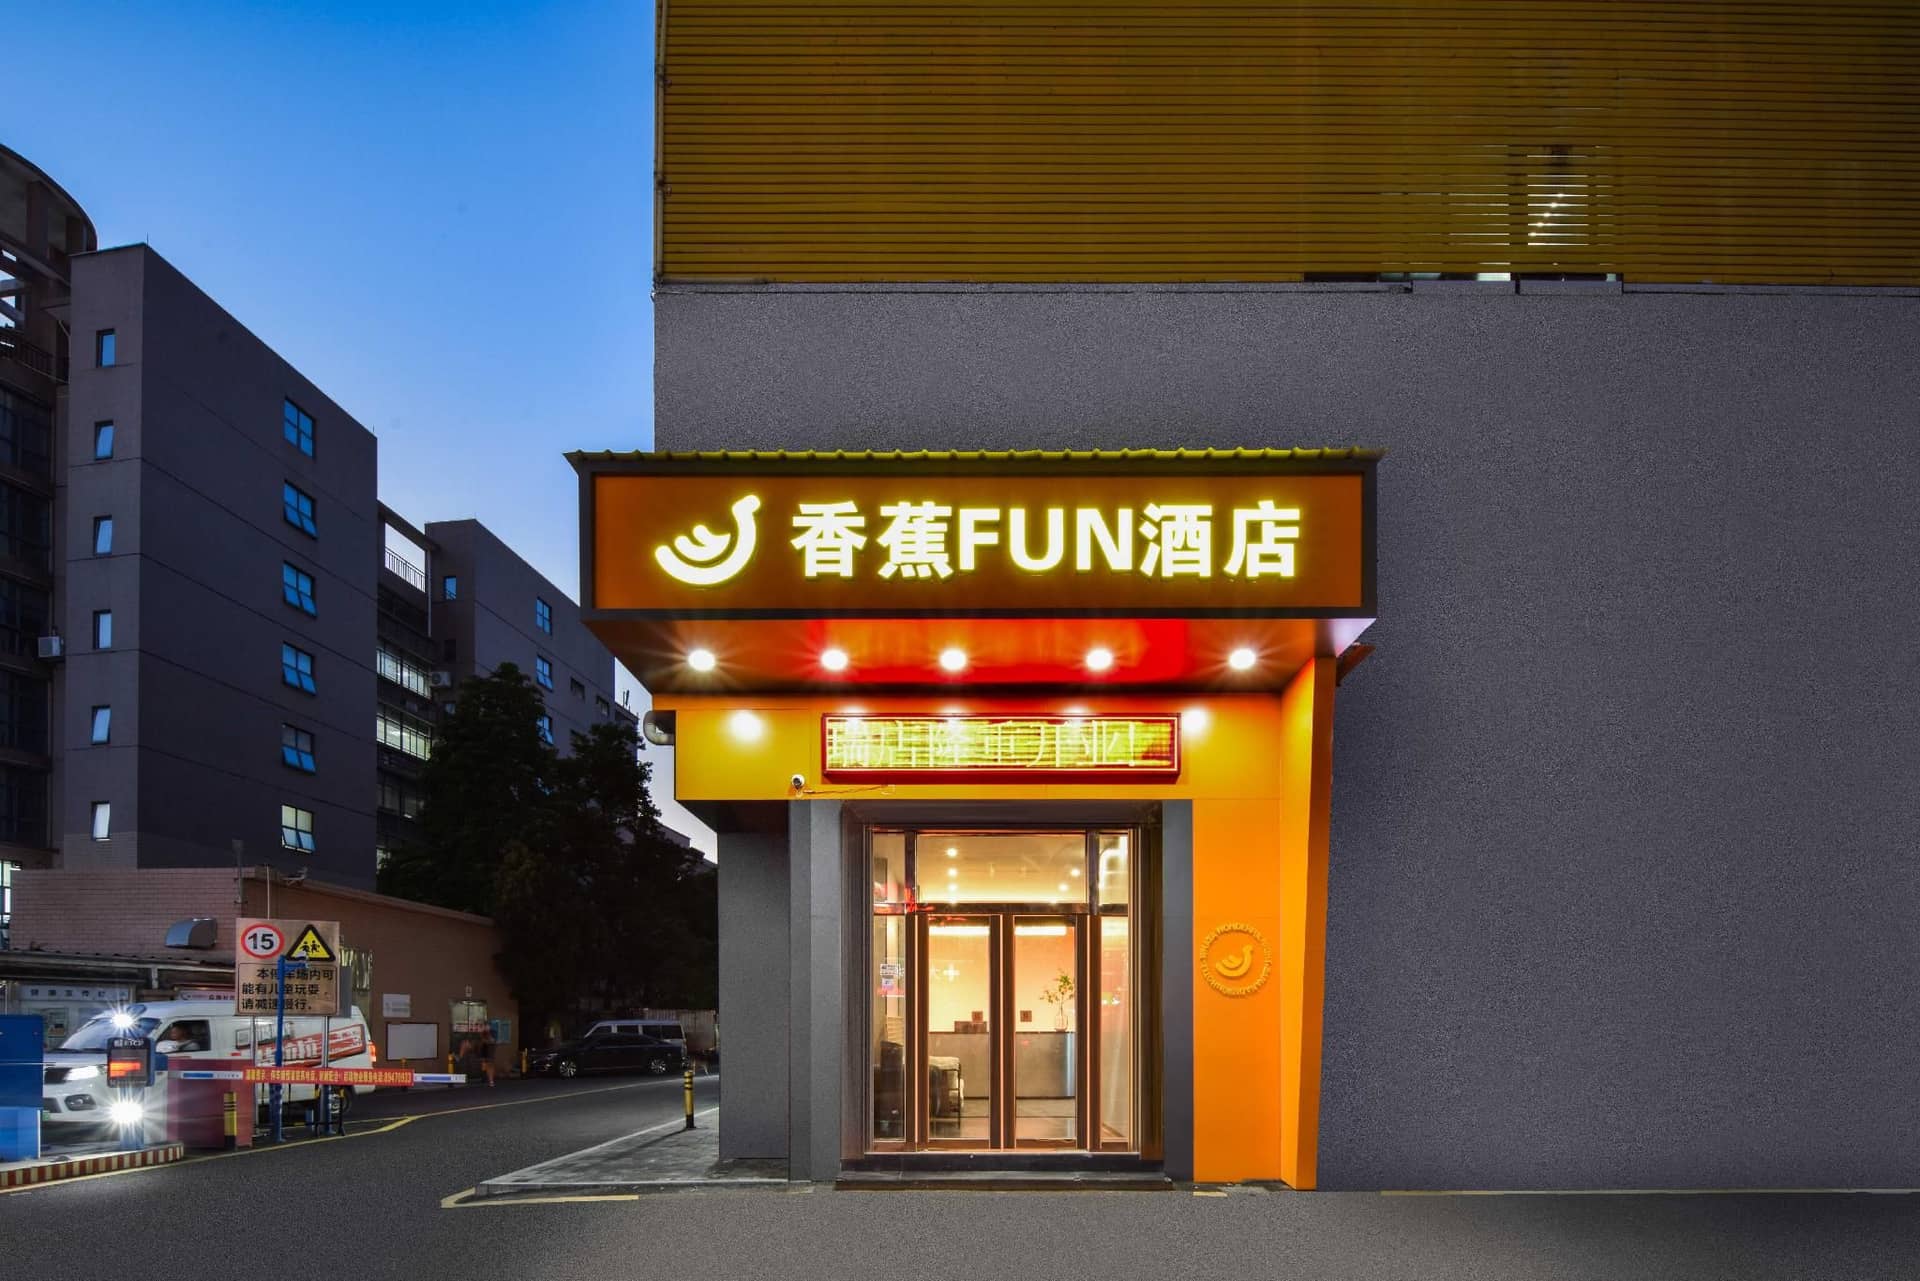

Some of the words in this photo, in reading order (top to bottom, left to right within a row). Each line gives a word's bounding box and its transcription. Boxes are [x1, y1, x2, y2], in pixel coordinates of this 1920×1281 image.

[791, 500, 1299, 578] 香蕉FUN酒店
[247, 933, 275, 950] 15
